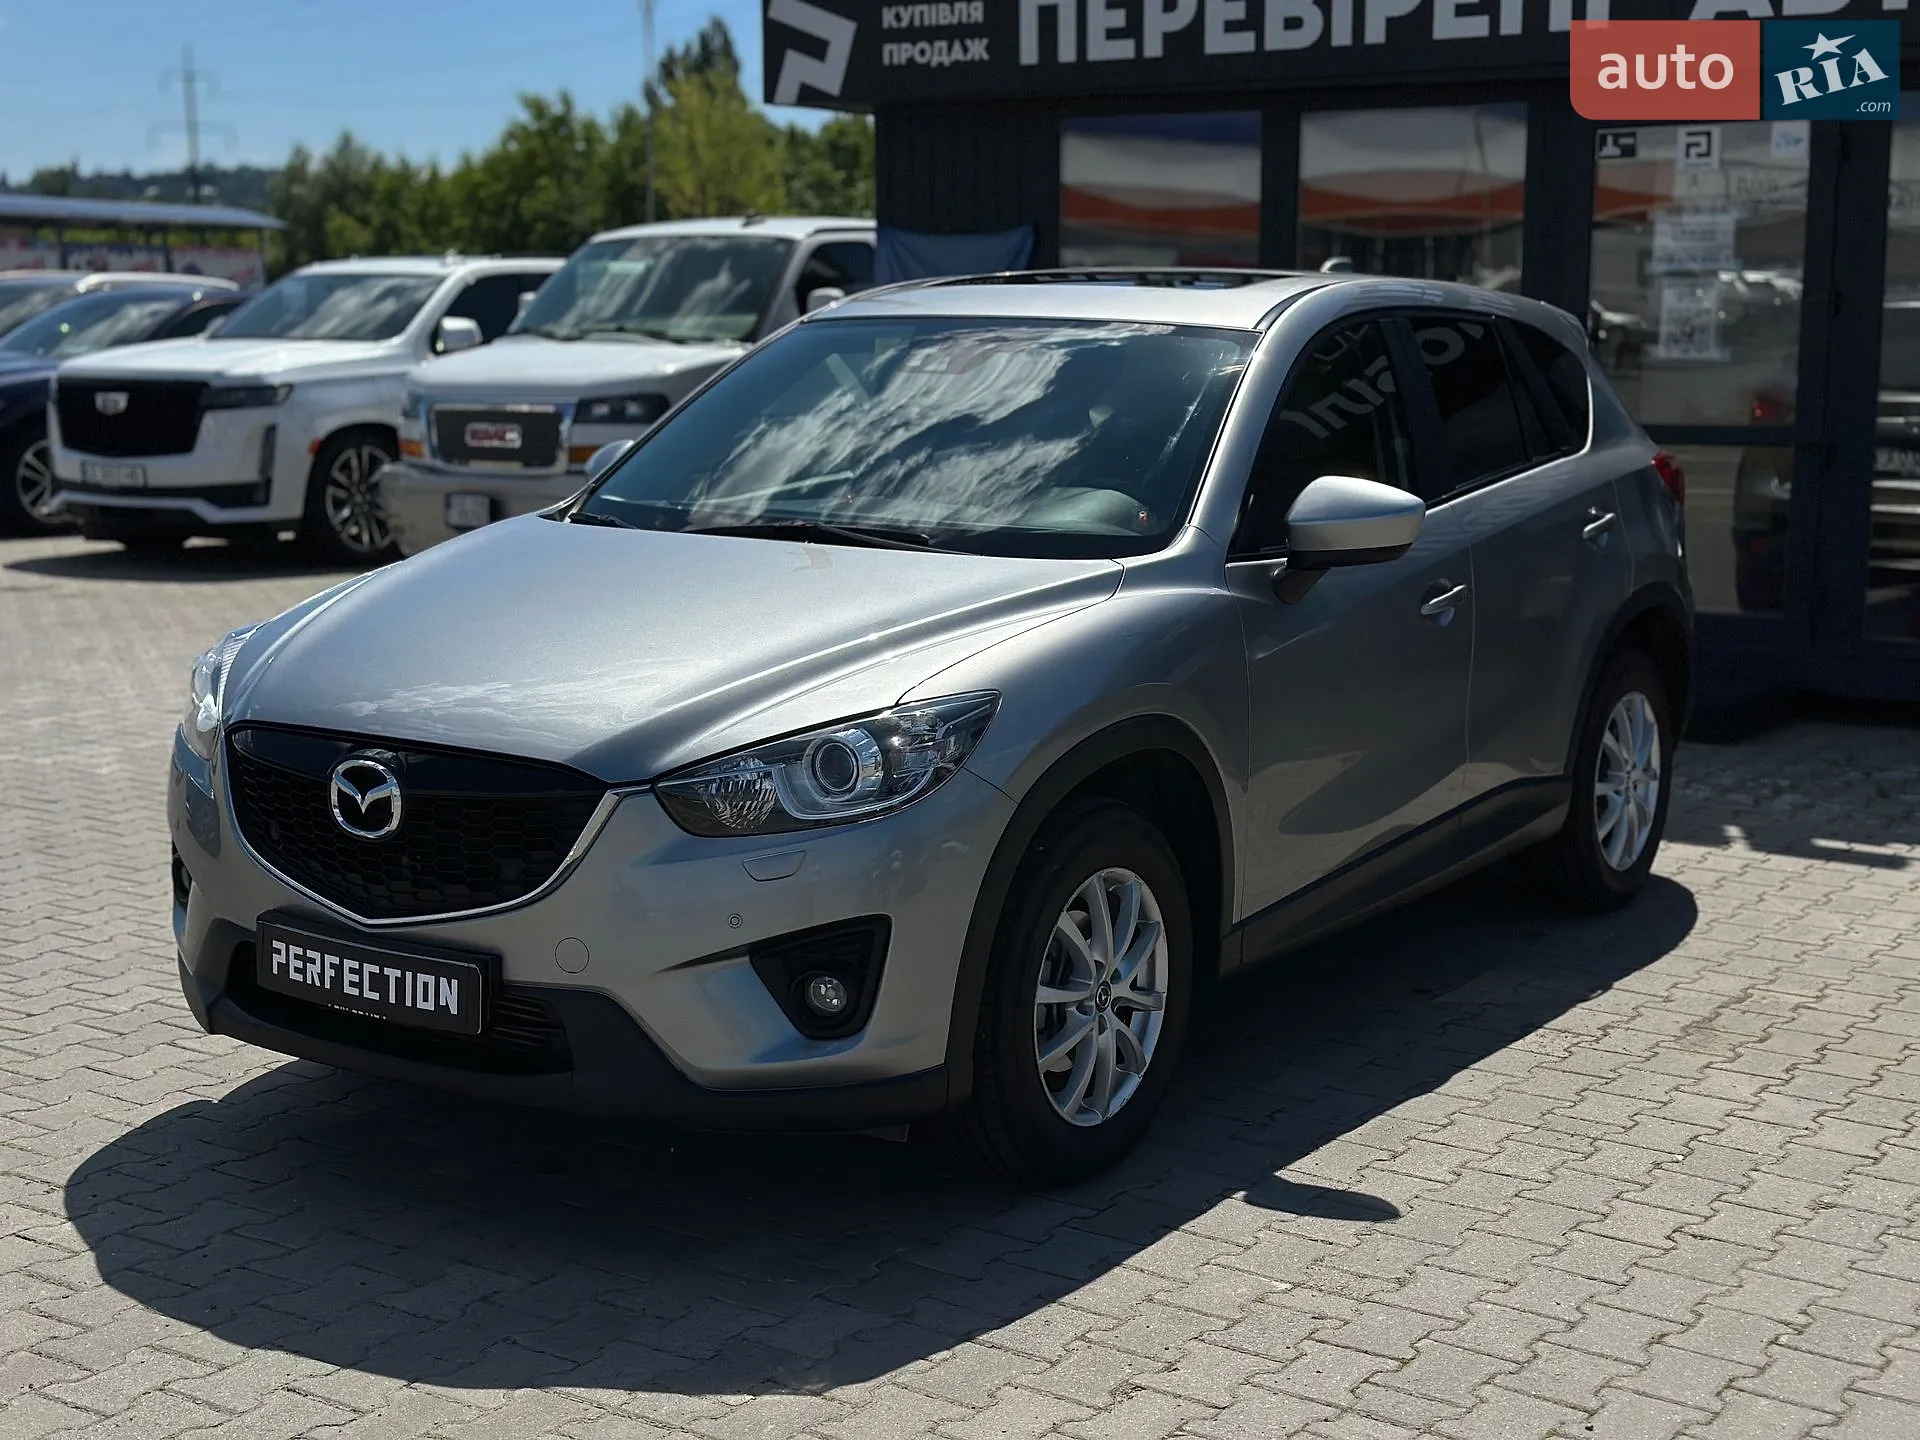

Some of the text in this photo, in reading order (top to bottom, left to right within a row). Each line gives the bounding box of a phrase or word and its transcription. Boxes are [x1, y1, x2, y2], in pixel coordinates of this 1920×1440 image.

[882, 1, 984, 29] КУПІВЛЯ
[882, 37, 990, 68] ПРОДАЖ
[272, 939, 458, 1015] PERFECTION
